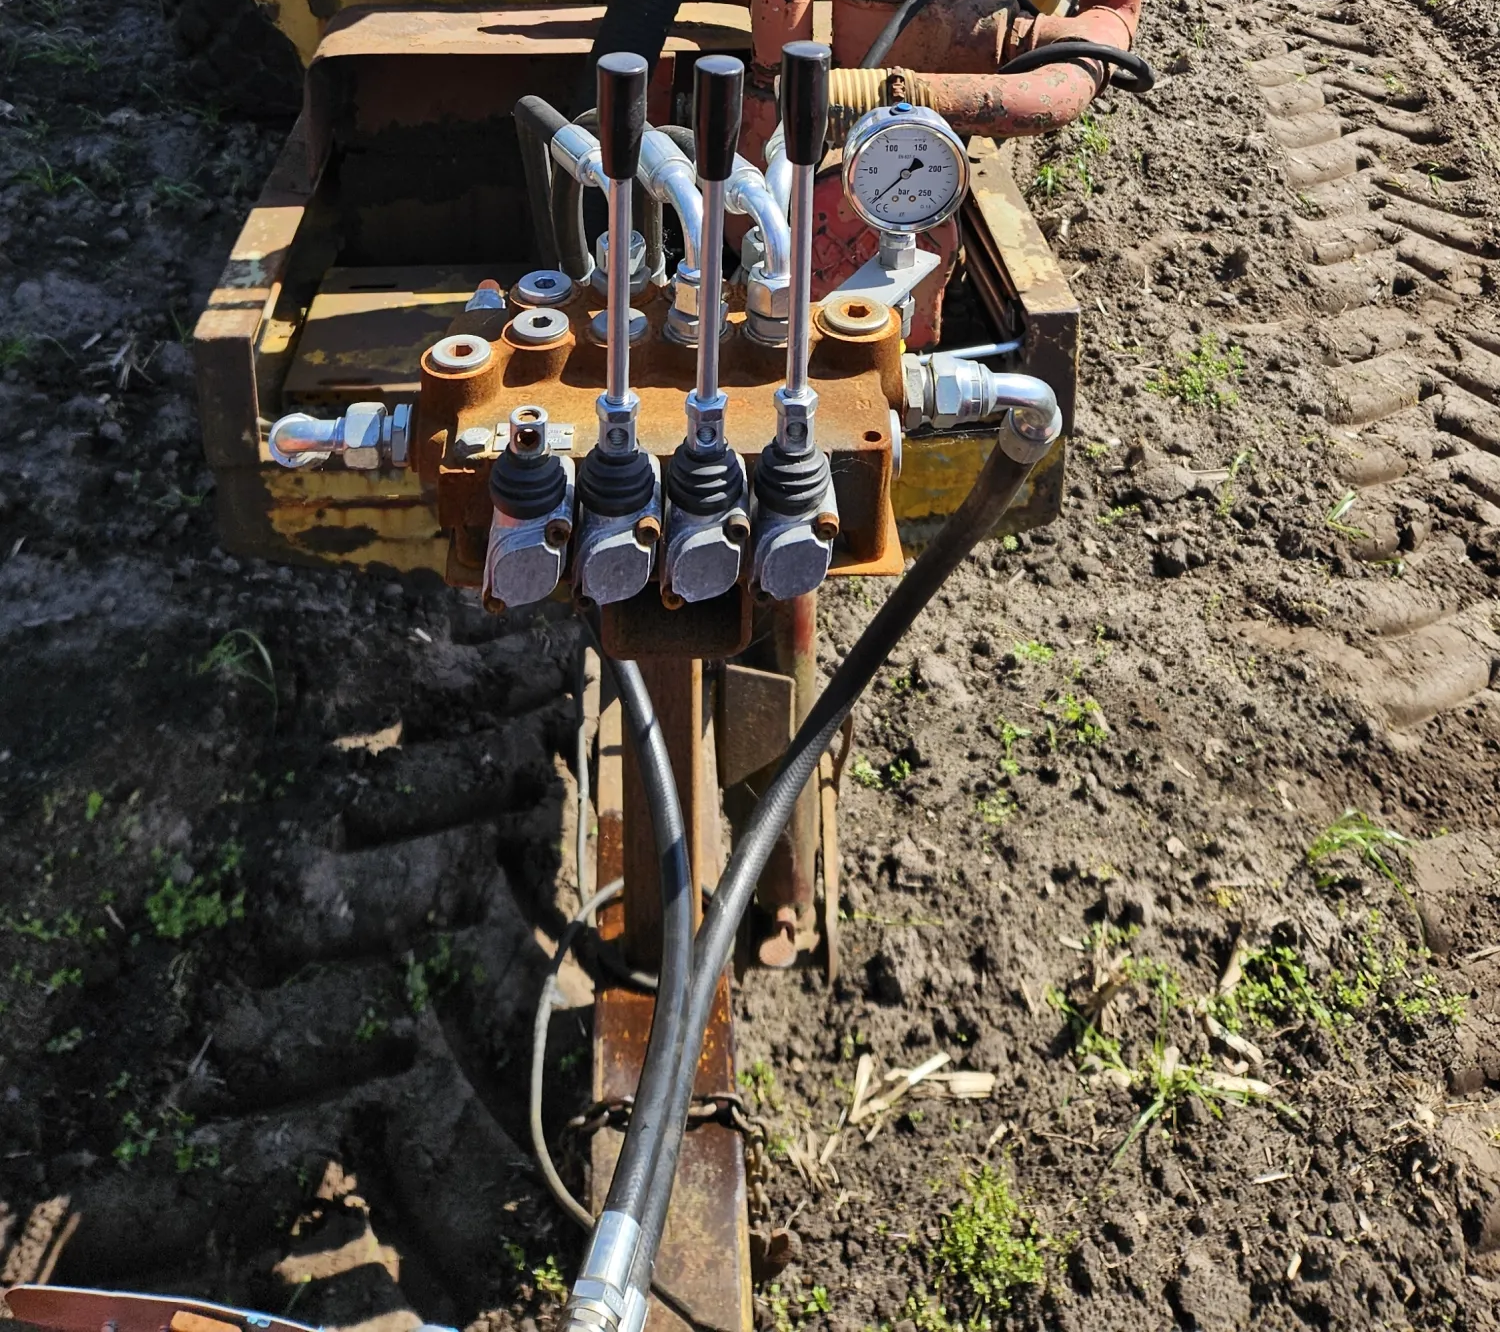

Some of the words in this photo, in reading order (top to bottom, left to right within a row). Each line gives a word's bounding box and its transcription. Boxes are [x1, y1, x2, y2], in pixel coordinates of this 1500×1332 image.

[885, 144, 899, 152] 100
[868, 166, 878, 174] 50
[928, 165, 942, 173] 200
[918, 189, 932, 197] 250
